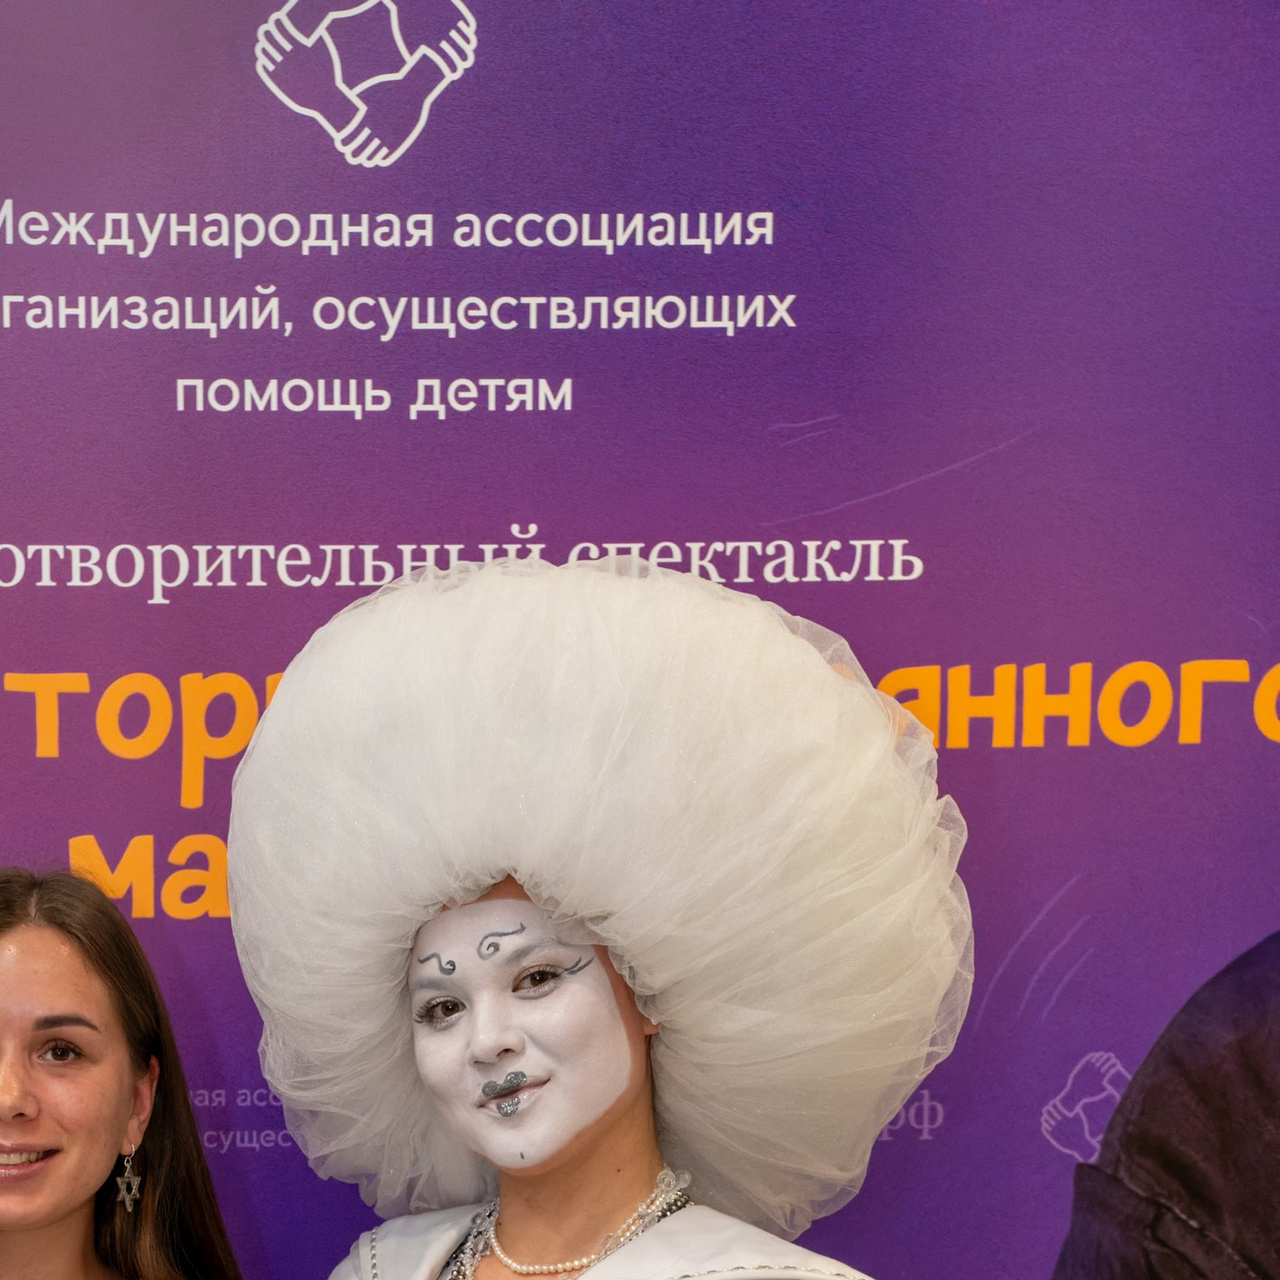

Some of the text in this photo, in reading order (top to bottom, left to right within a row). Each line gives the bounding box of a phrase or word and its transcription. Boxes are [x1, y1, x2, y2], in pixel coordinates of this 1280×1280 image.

[453, 209, 774, 255] ассоциация
[312, 291, 797, 342] осуществляющих
[175, 377, 573, 420] помощь детям
[68, 833, 232, 920] ма
[203, 1129, 293, 1153] сущес
